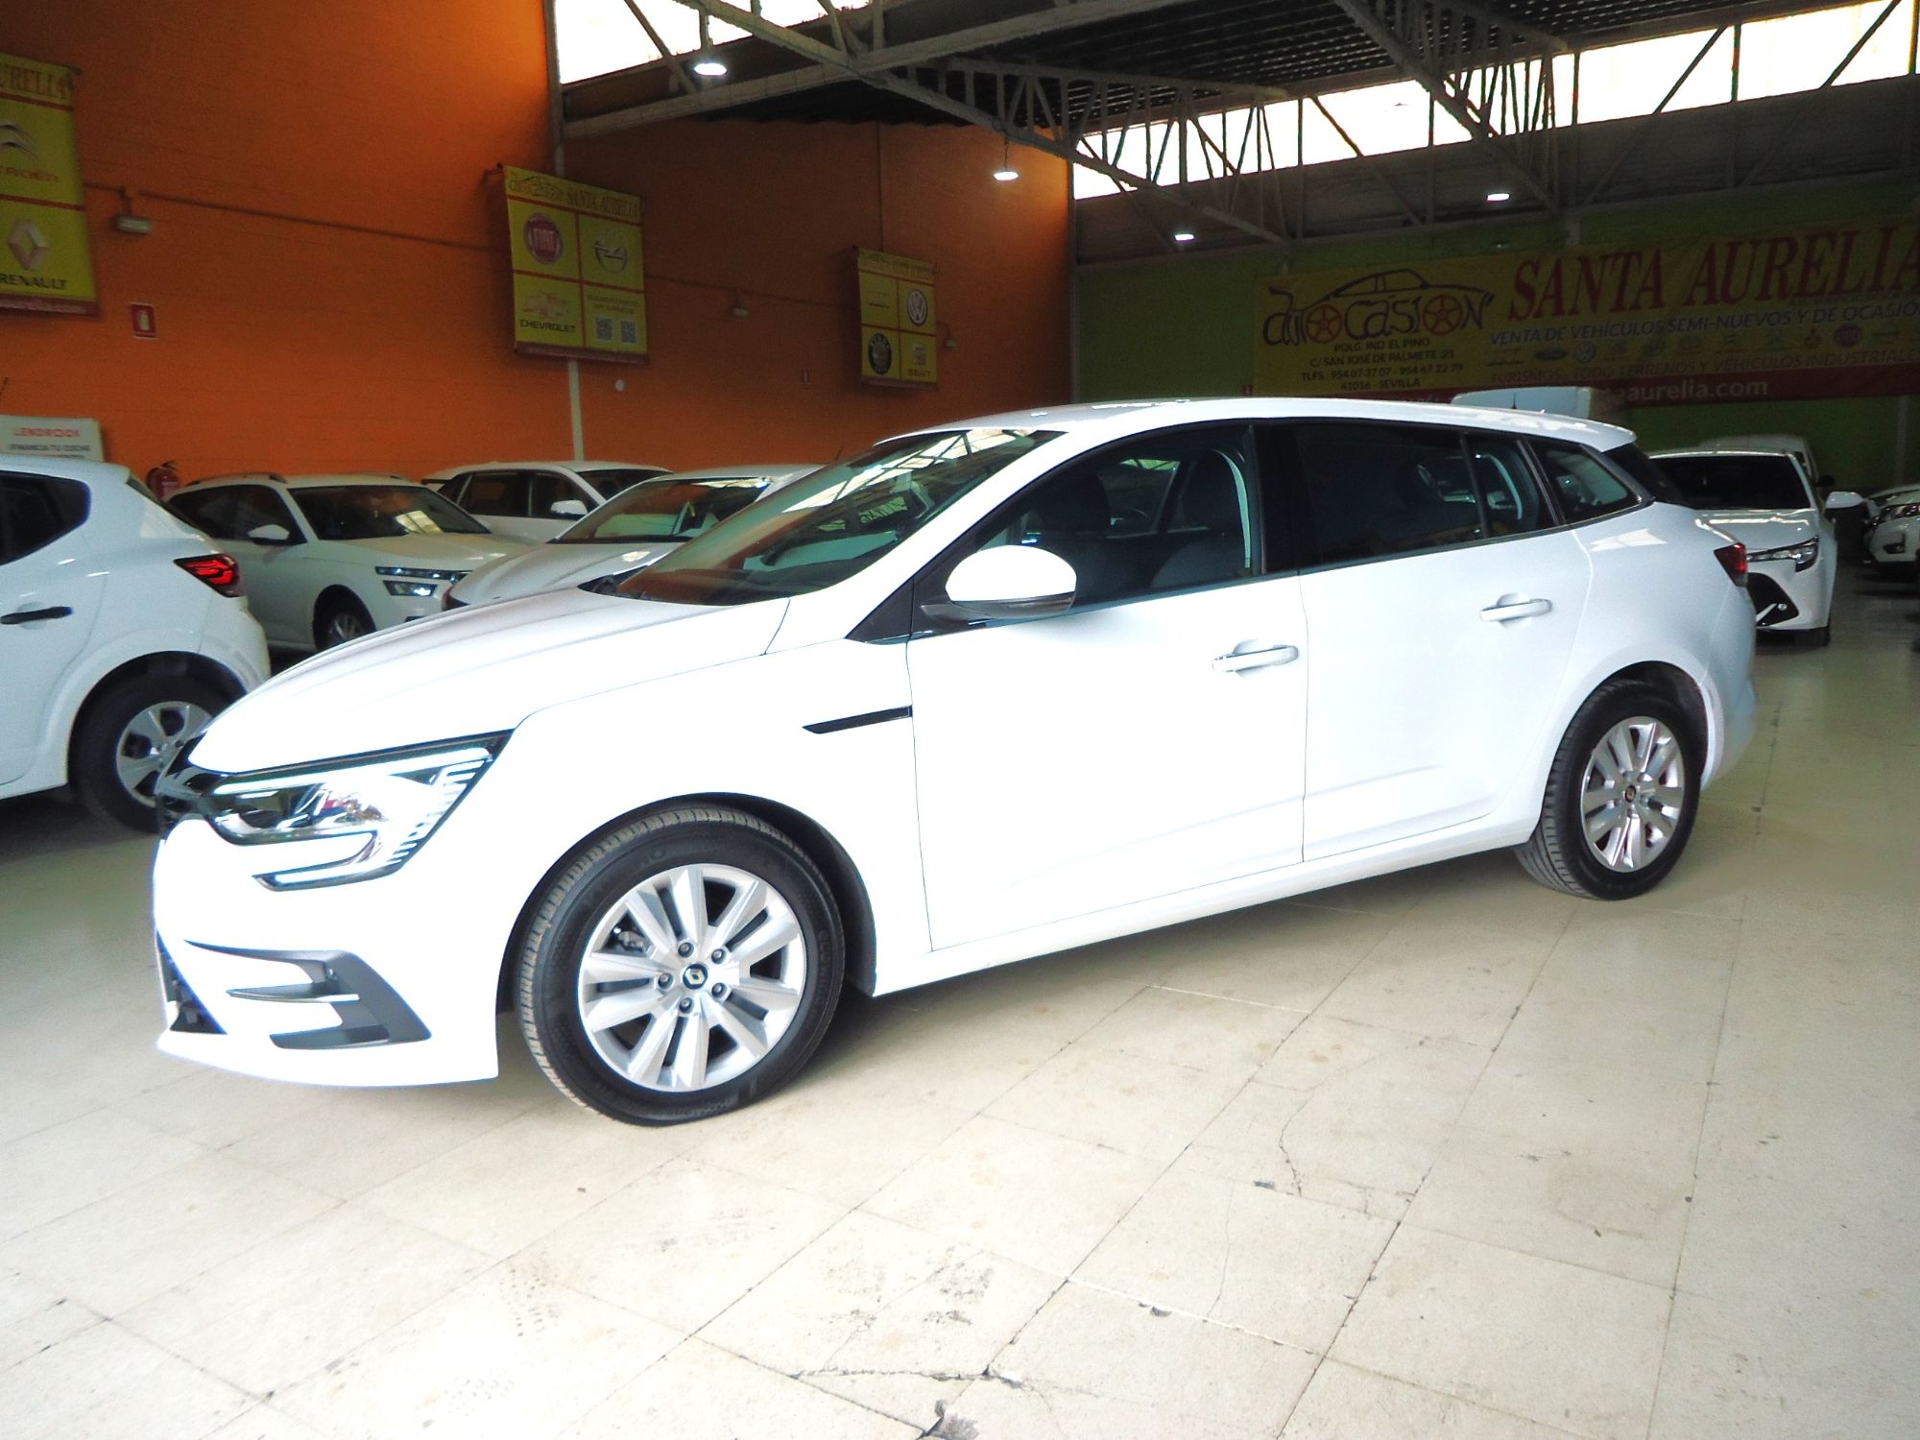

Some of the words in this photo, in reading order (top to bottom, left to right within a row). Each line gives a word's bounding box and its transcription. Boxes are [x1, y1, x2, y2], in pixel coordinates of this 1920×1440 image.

[1508, 248, 1665, 321] SANTA
[520, 319, 575, 333] CHEVROLET
[1490, 329, 1541, 345] VENTA
[1545, 327, 1566, 342] DE
[1666, 311, 1792, 333] SEMI-NUEVOS
[1797, 309, 1809, 323] Y
[1812, 307, 1838, 323] DE
[1843, 297, 1920, 321] OCASIÓ
[1403, 337, 1430, 347] PINO
[1324, 356, 1344, 366] SAN
[1373, 353, 1387, 363] DE
[1389, 350, 1436, 362] PALMETE
[1379, 378, 1421, 389] SEVILLA
[1628, 379, 1768, 401] aurelia.com
